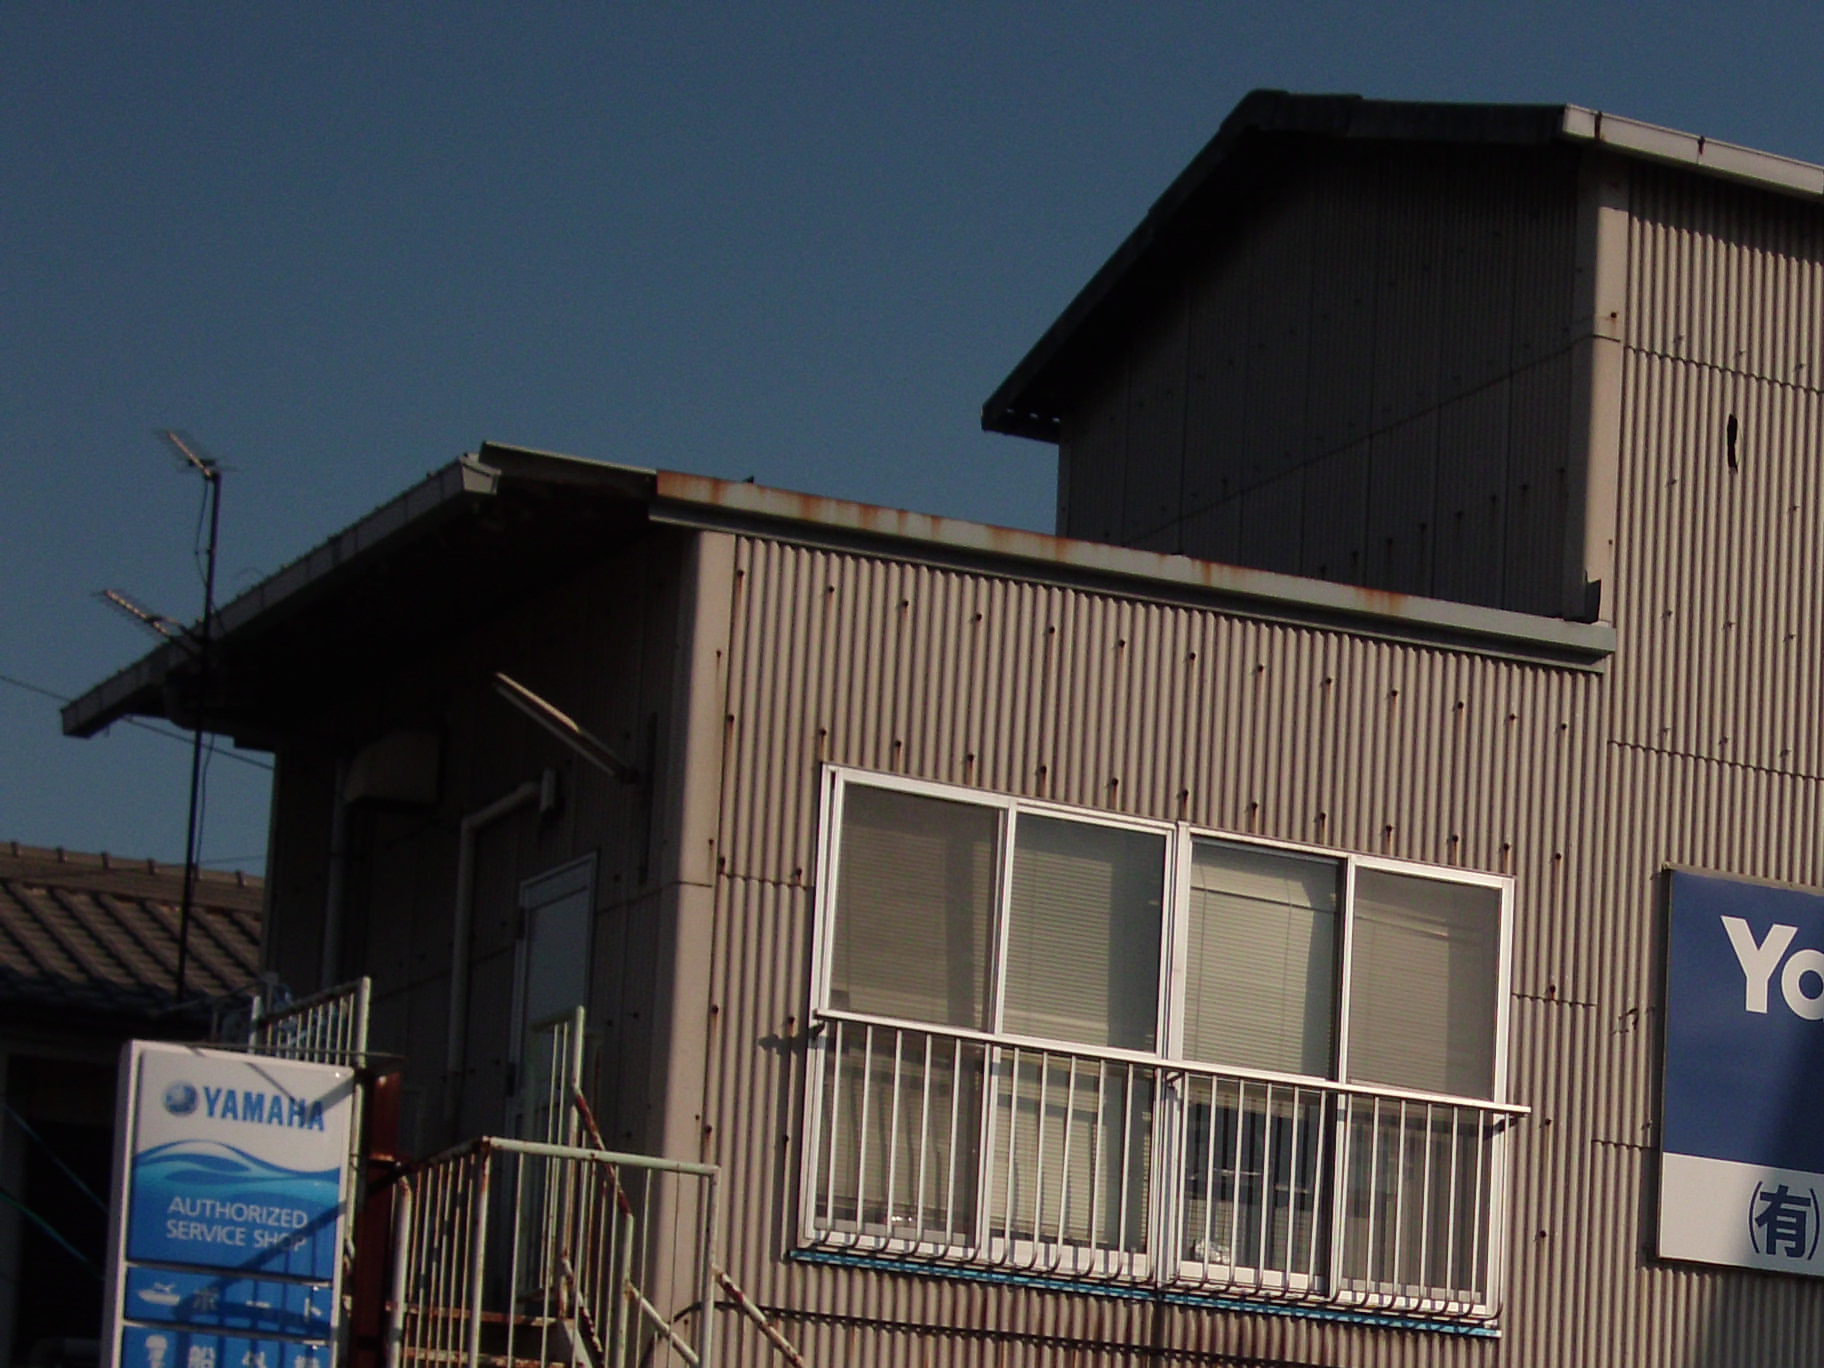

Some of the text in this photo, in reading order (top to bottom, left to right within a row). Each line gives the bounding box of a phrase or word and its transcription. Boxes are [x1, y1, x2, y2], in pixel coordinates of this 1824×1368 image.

[203, 1086, 325, 1132] YAMAHA
[166, 1195, 309, 1229] AUTHORIZED
[166, 1219, 308, 1252] SERVICE SHOP
